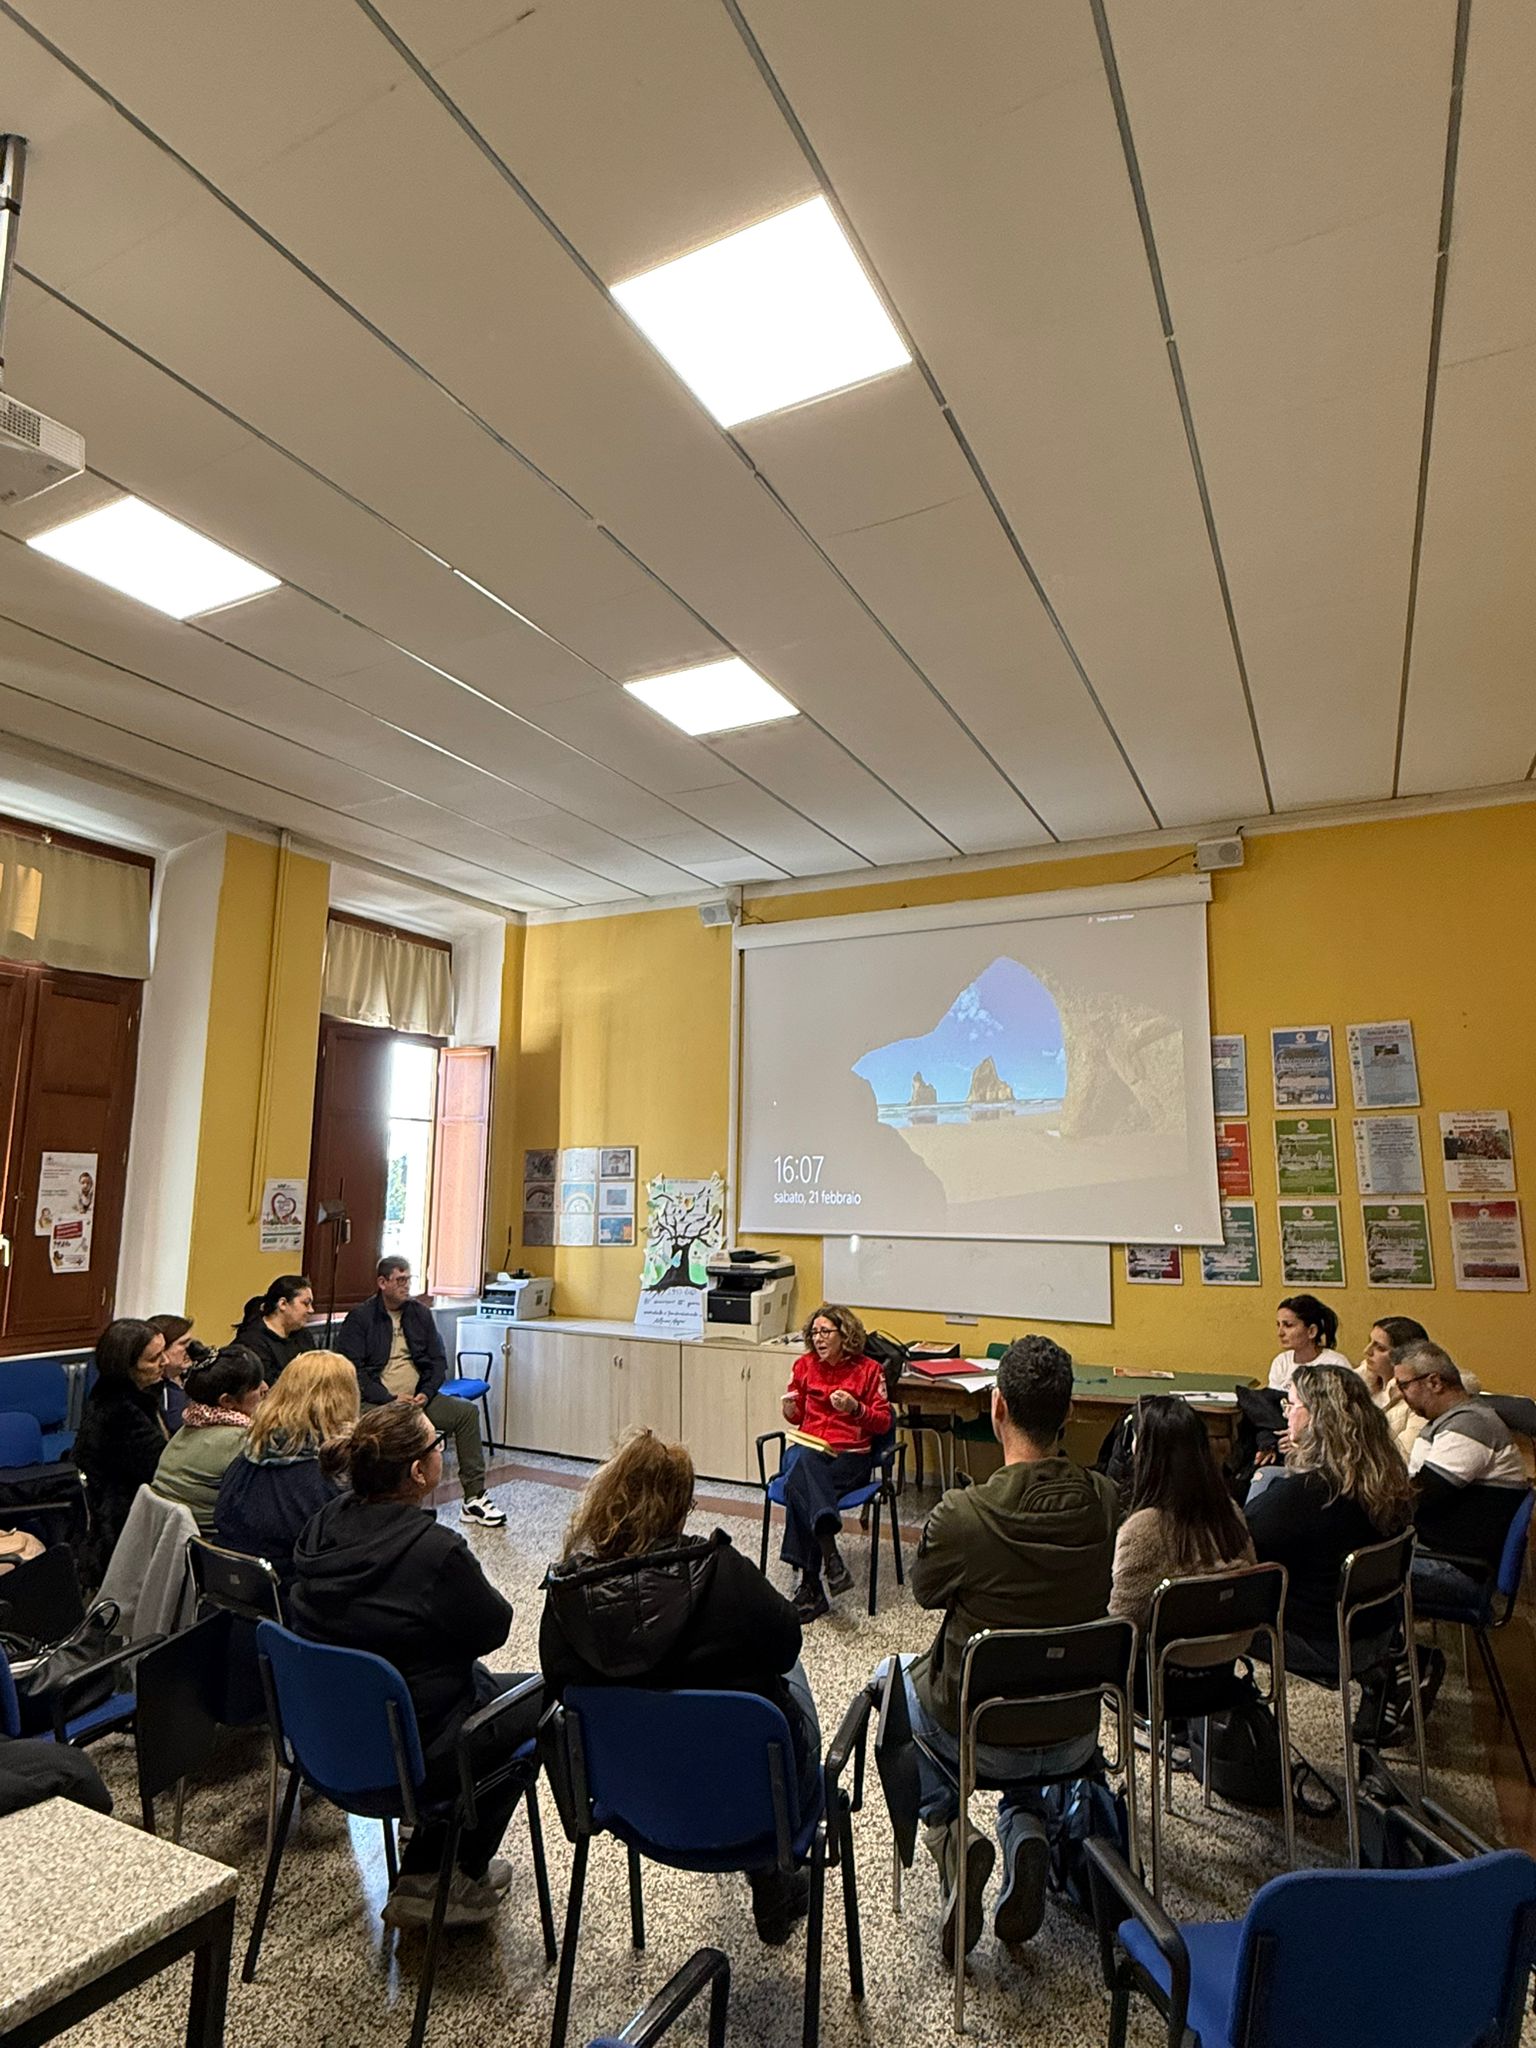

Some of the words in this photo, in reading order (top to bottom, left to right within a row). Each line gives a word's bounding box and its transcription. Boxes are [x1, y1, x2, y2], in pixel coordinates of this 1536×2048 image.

[774, 1155, 825, 1184] 16:07
[773, 1190, 807, 1206] sabato,
[808, 1190, 819, 1204] 21
[821, 1190, 862, 1205] febbraio
